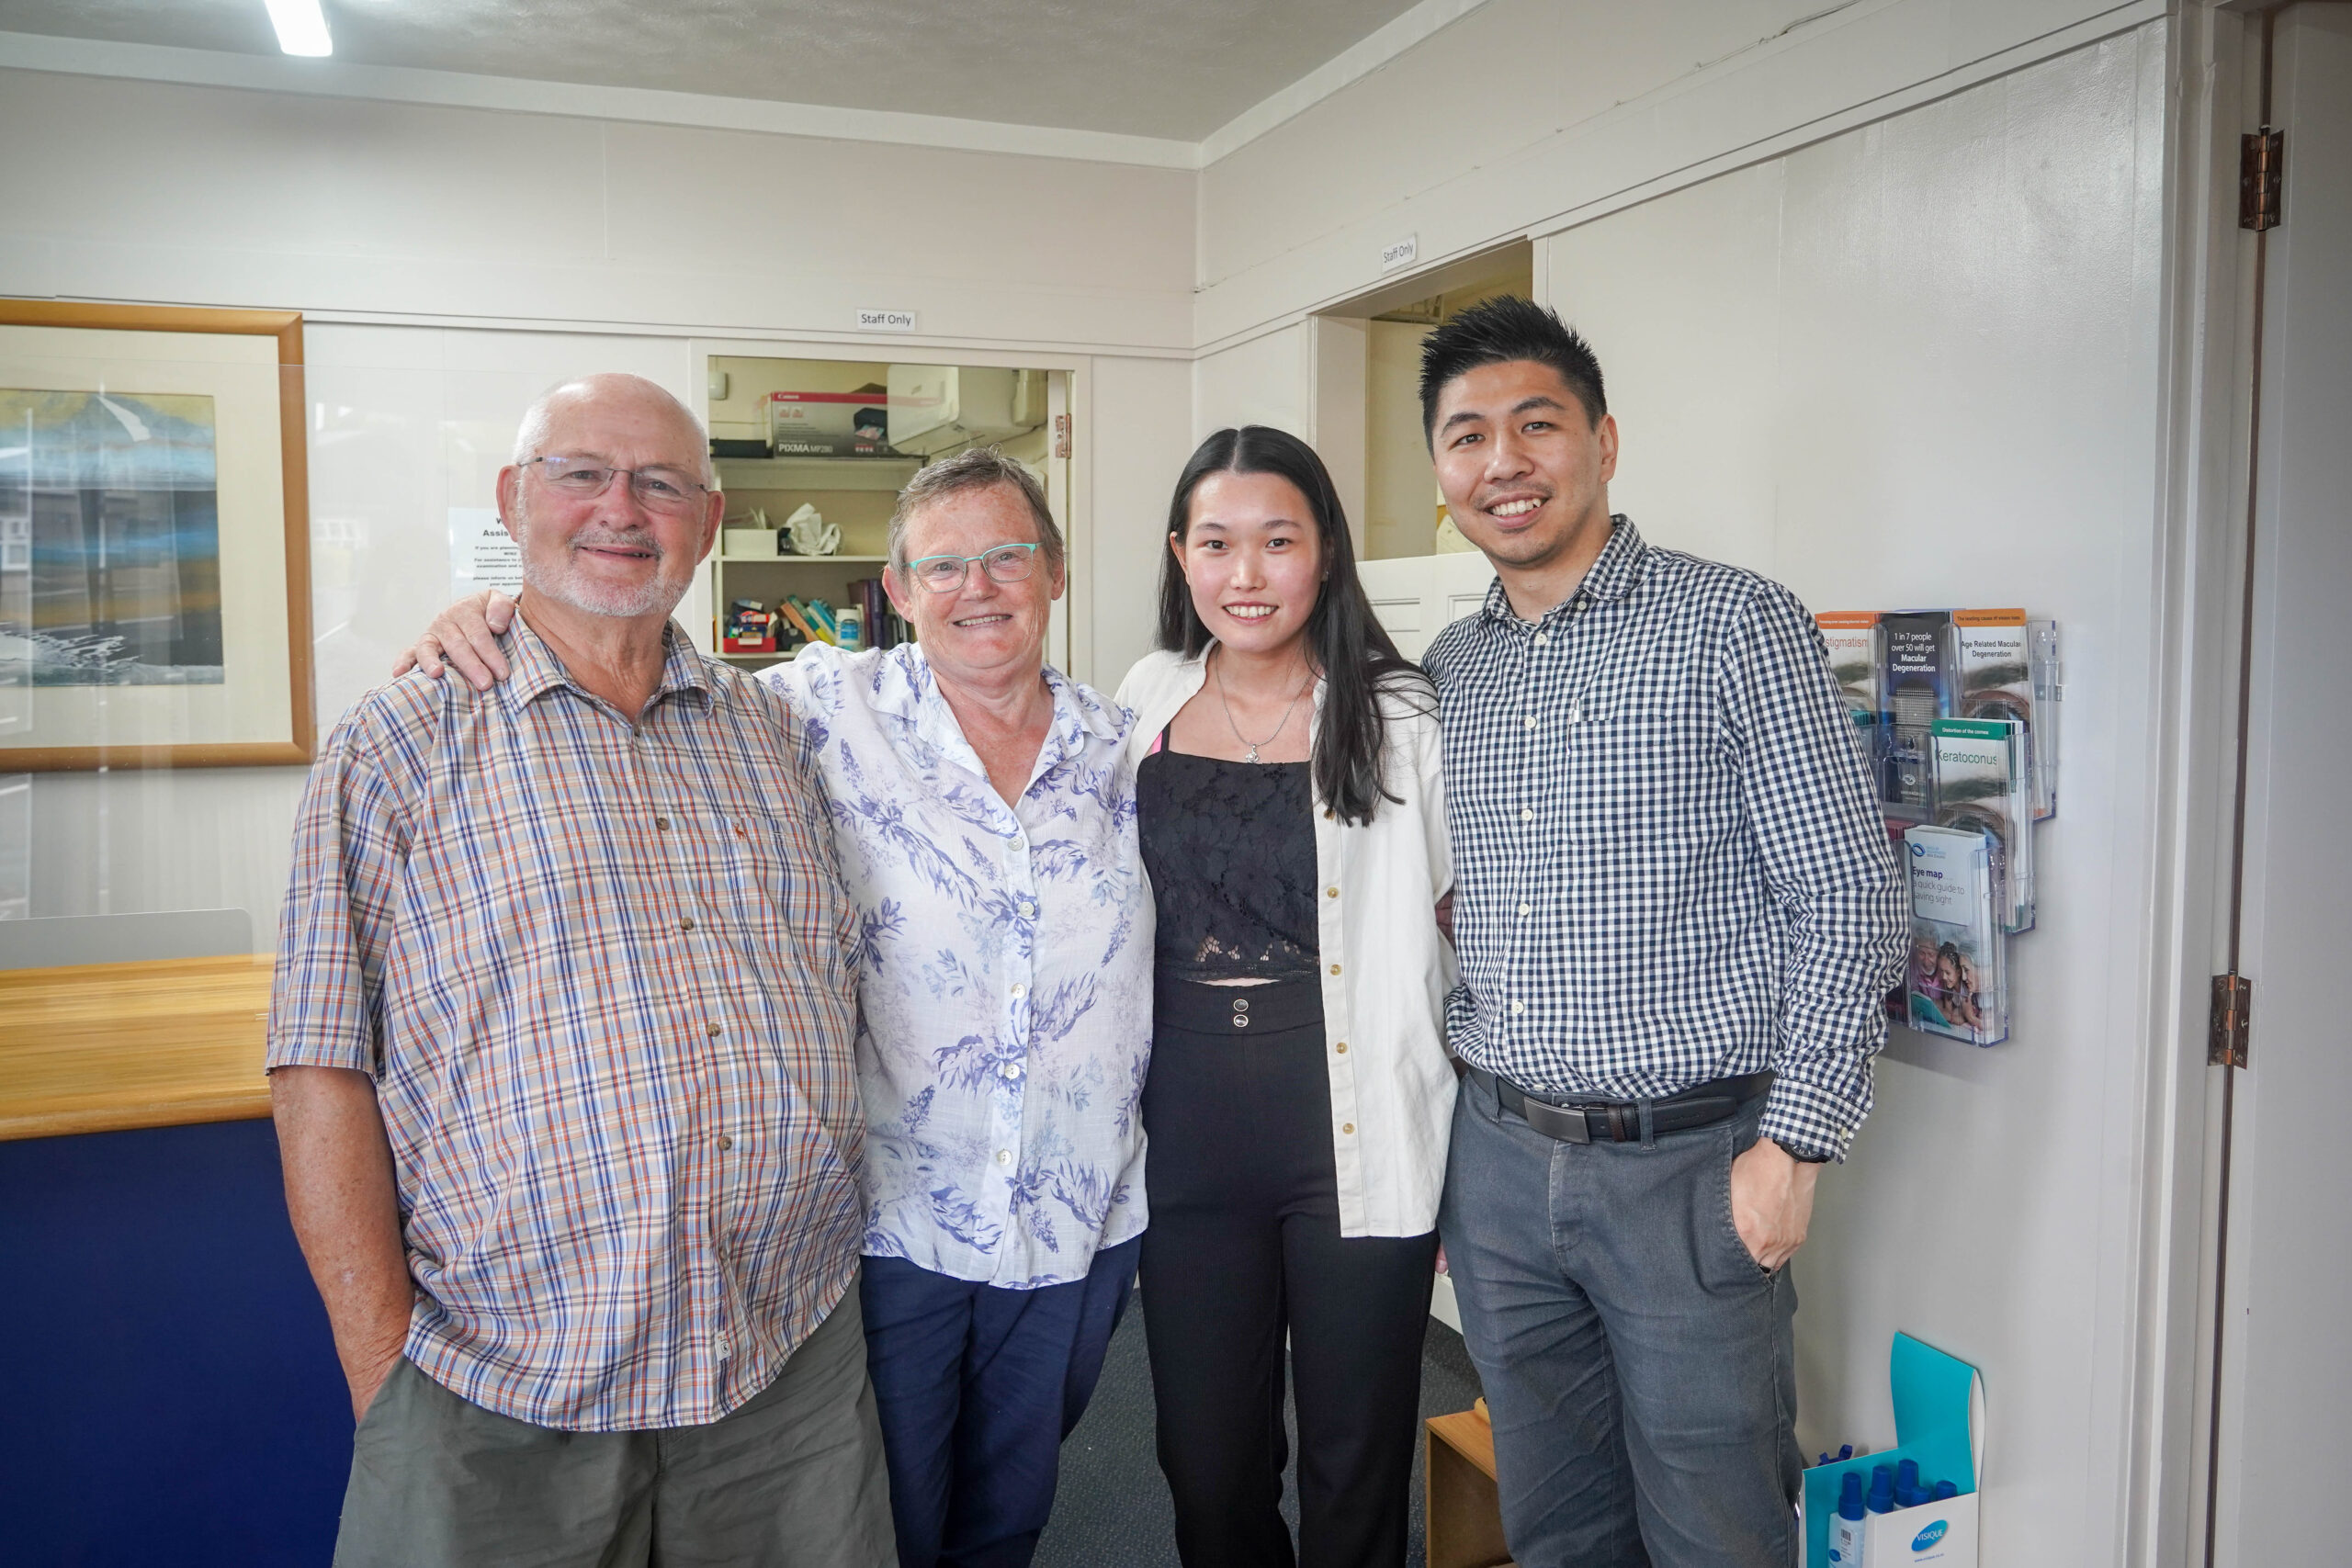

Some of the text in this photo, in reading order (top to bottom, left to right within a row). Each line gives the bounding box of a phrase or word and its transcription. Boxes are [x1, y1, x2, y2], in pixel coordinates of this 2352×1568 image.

[1383, 243, 1414, 264] Staff Only
[861, 313, 911, 327] Staff Only
[778, 443, 809, 453] PIXMA
[1899, 632, 1905, 640] in
[1911, 632, 1932, 642] people
[1825, 636, 1869, 650] stigmatism
[1905, 643, 1913, 651] 50
[1914, 643, 1925, 651] will
[1925, 644, 1936, 653] get
[1961, 640, 1973, 649] Age
[1901, 653, 1927, 661] Macular
[1972, 649, 2012, 659] Degeneration
[1893, 663, 1936, 673] Degeneration
[1935, 749, 1997, 765] Keratoconus
[1912, 866, 1943, 881] Eye map
[1917, 881, 1937, 890] quick
[1937, 884, 1956, 894] guide
[1957, 886, 1965, 895] to
[1935, 895, 1952, 906] sight
